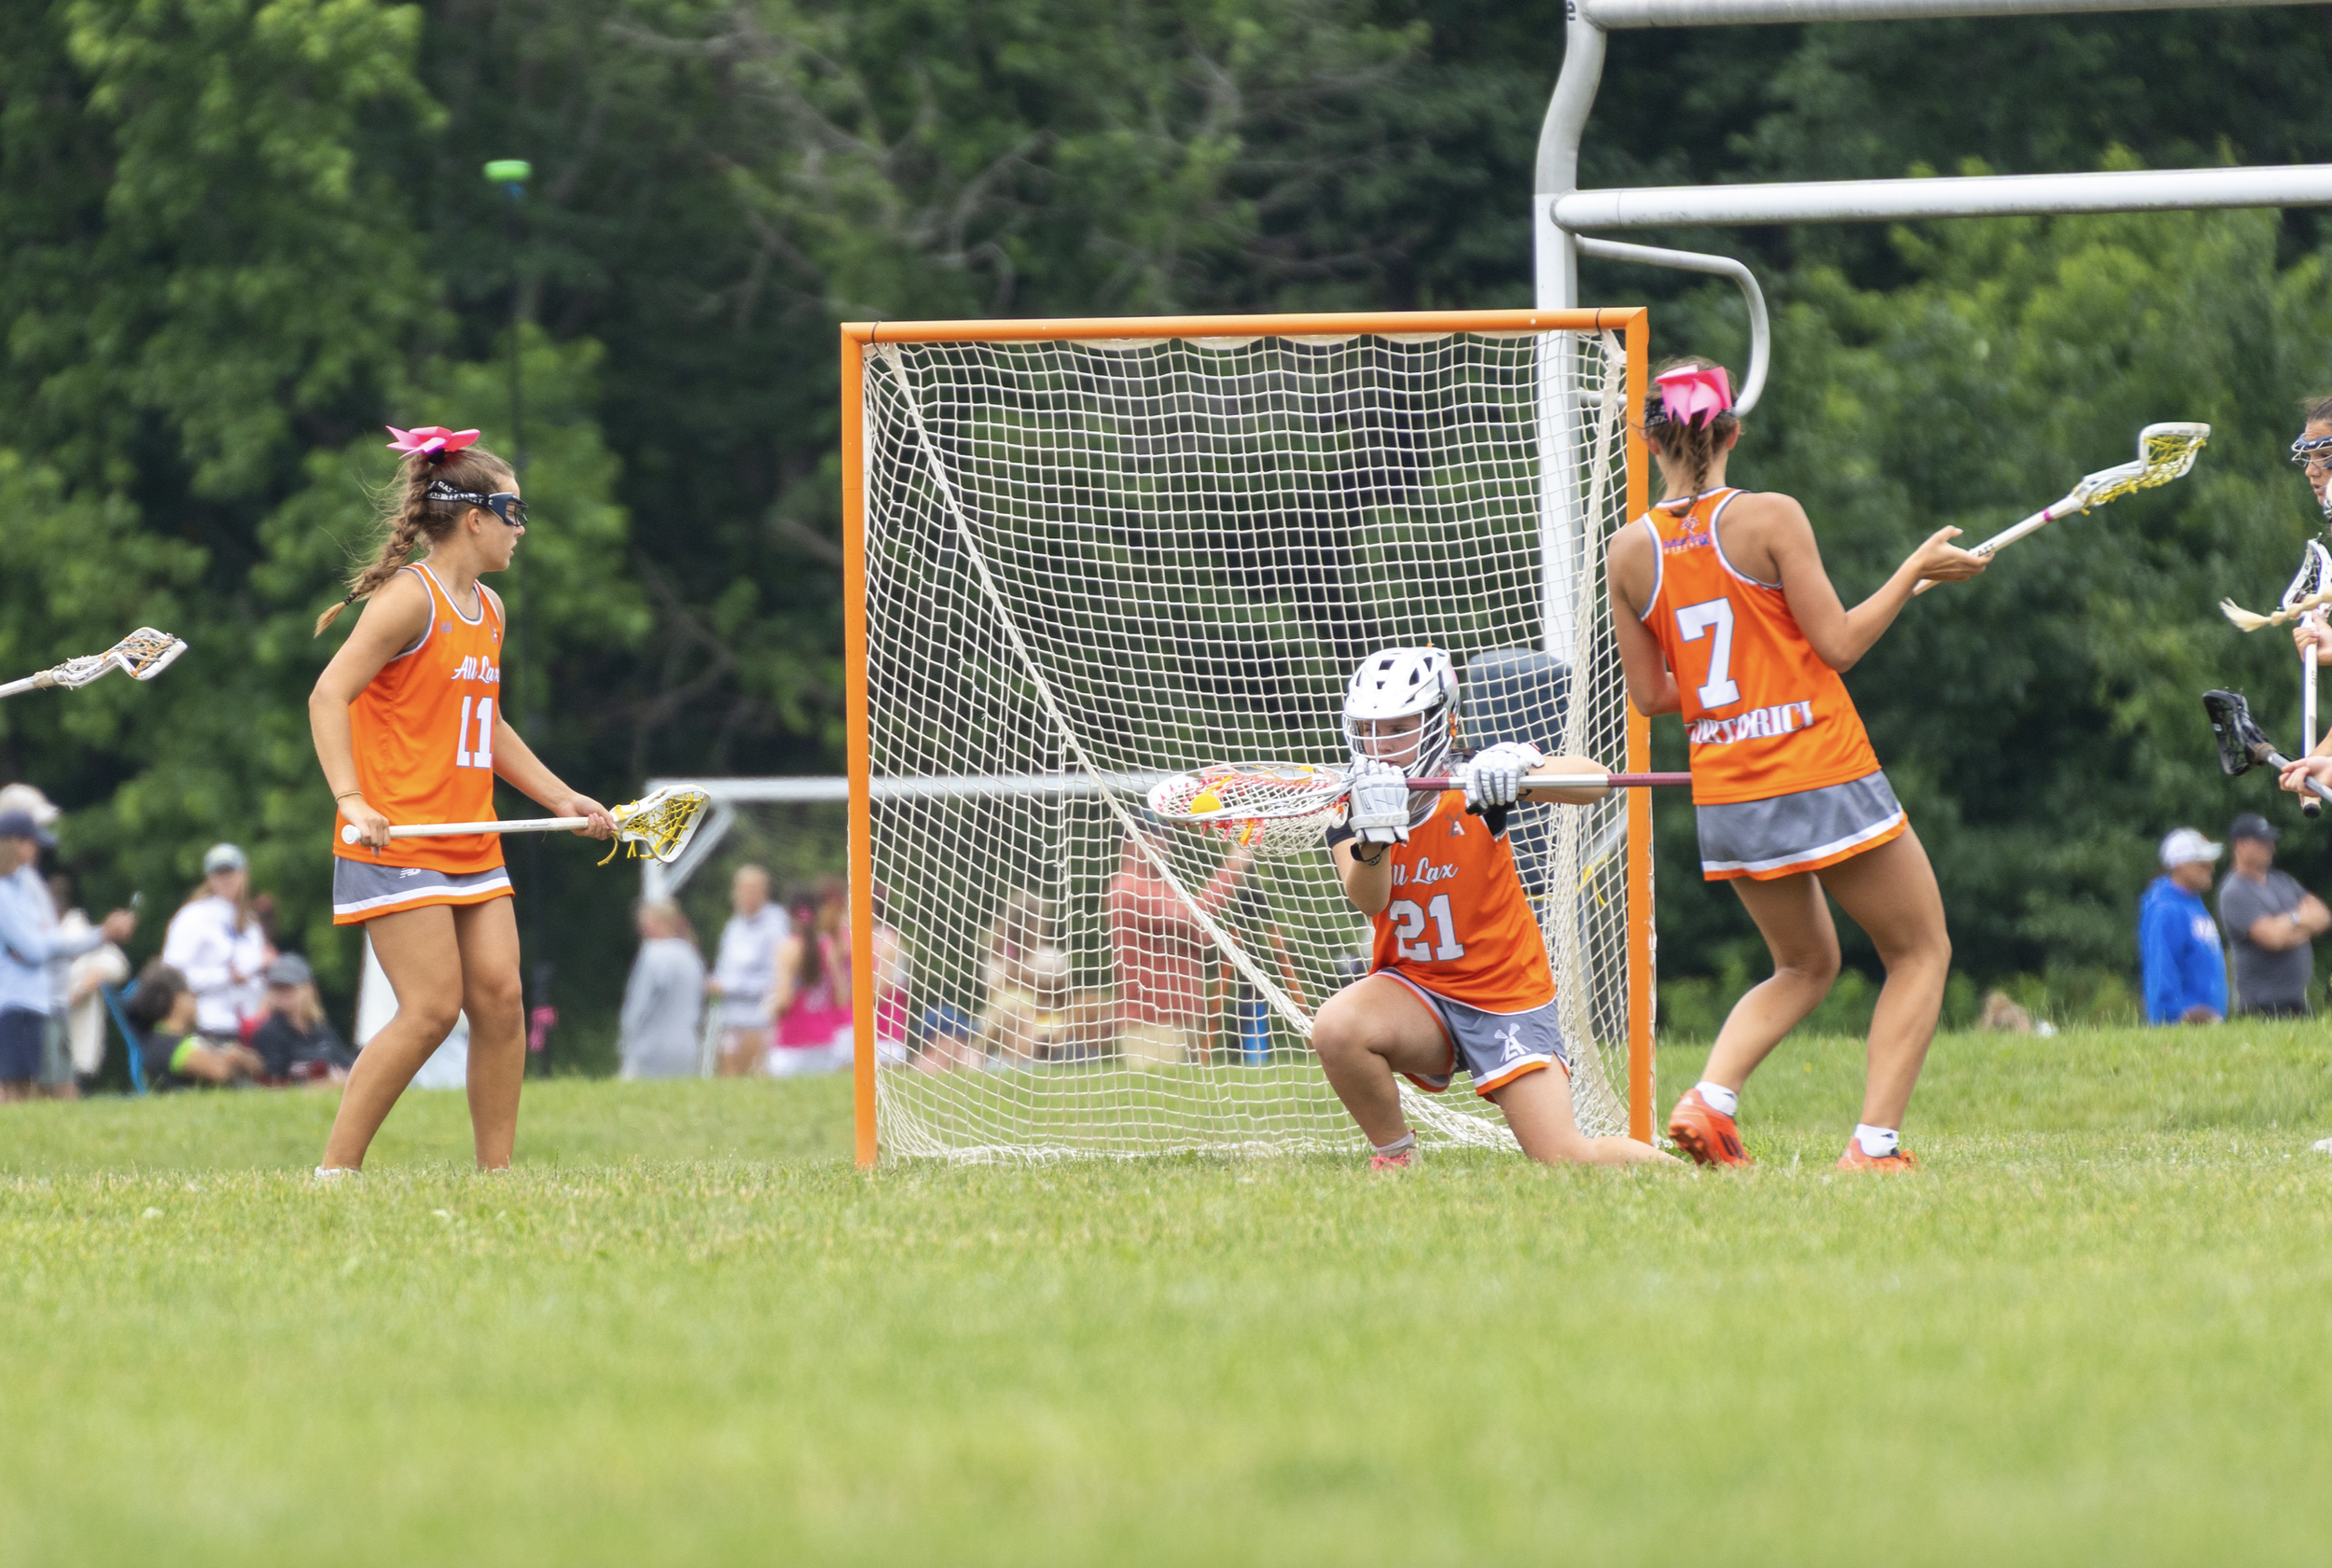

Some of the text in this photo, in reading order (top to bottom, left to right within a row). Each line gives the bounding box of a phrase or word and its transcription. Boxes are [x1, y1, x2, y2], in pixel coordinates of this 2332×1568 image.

[1972, 543, 1996, 558] AIT
[451, 654, 500, 685] All Lax
[1674, 596, 1742, 711] 7
[456, 695, 493, 770] 11
[1393, 863, 1409, 886] ll
[1410, 855, 1459, 885] Lax
[1388, 892, 1465, 963] 21
